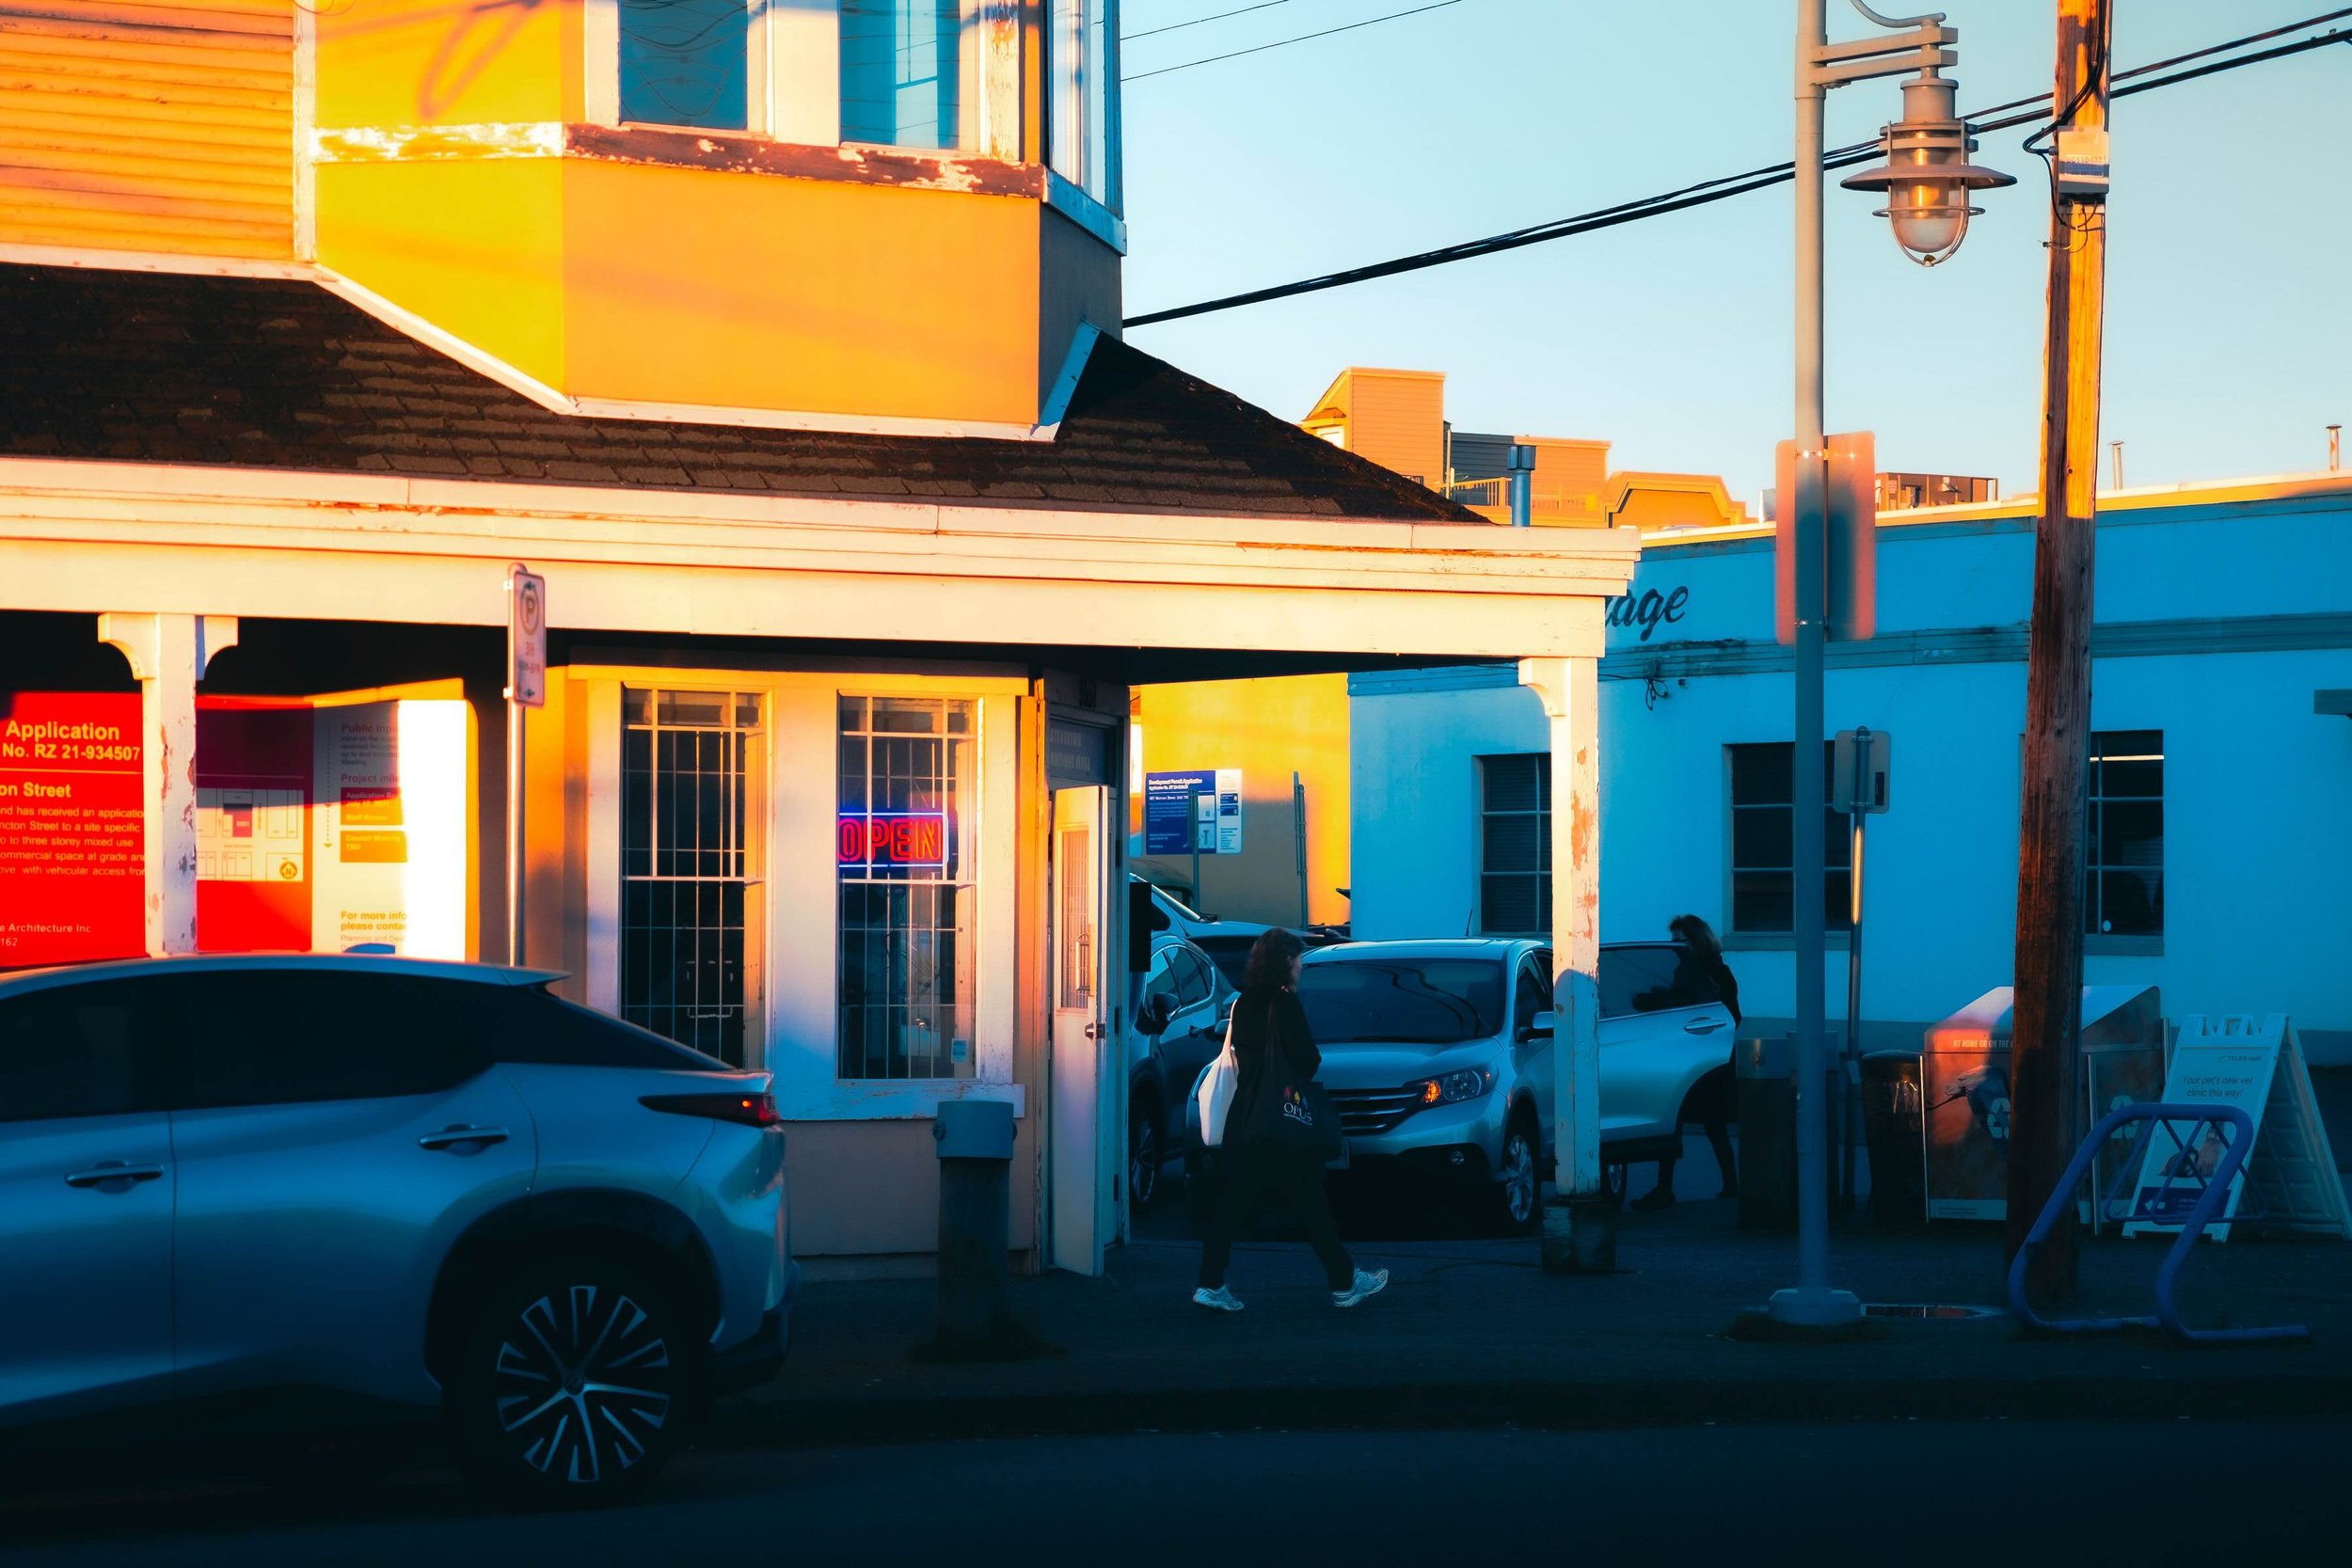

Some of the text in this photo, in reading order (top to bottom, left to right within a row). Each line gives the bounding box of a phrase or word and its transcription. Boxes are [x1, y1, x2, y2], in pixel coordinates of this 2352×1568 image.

[6, 720, 120, 741] Application
[3, 742, 141, 761] No. RZ 21-934507
[341, 773, 376, 784] Project
[23, 782, 72, 798] Street
[16, 805, 35, 816] has
[38, 806, 80, 817] received
[82, 808, 95, 817] an
[97, 808, 144, 819] applicatio
[29, 820, 59, 832] Street
[62, 822, 72, 832] to
[84, 823, 102, 832] site
[103, 823, 140, 833] specific
[9, 836, 20, 845] to
[22, 835, 48, 846] three
[51, 836, 82, 847] storey
[84, 837, 113, 847] mixed
[837, 818, 942, 862] OPEN
[55, 852, 85, 863] space
[99, 852, 128, 863] grade
[22, 865, 42, 875] with
[45, 865, 89, 876] vehicular
[92, 867, 126, 876] access
[341, 911, 358, 920] For
[360, 912, 387, 921] more
[8, 923, 73, 933] Architecture
[75, 924, 92, 933] Inc
[341, 921, 373, 932] please
[1962, 1039, 1979, 1048] HOME
[1979, 1039, 1988, 1048] OR
[1988, 1039, 1997, 1048] ON
[1997, 1039, 2010, 1049] THE
[2183, 1075, 2201, 1085] Your
[2201, 1075, 2220, 1086] pet's
[2240, 1076, 2253, 1085] vet
[2185, 1088, 2244, 1099] clinic this way!
[1283, 1101, 1312, 1123] OPUS
